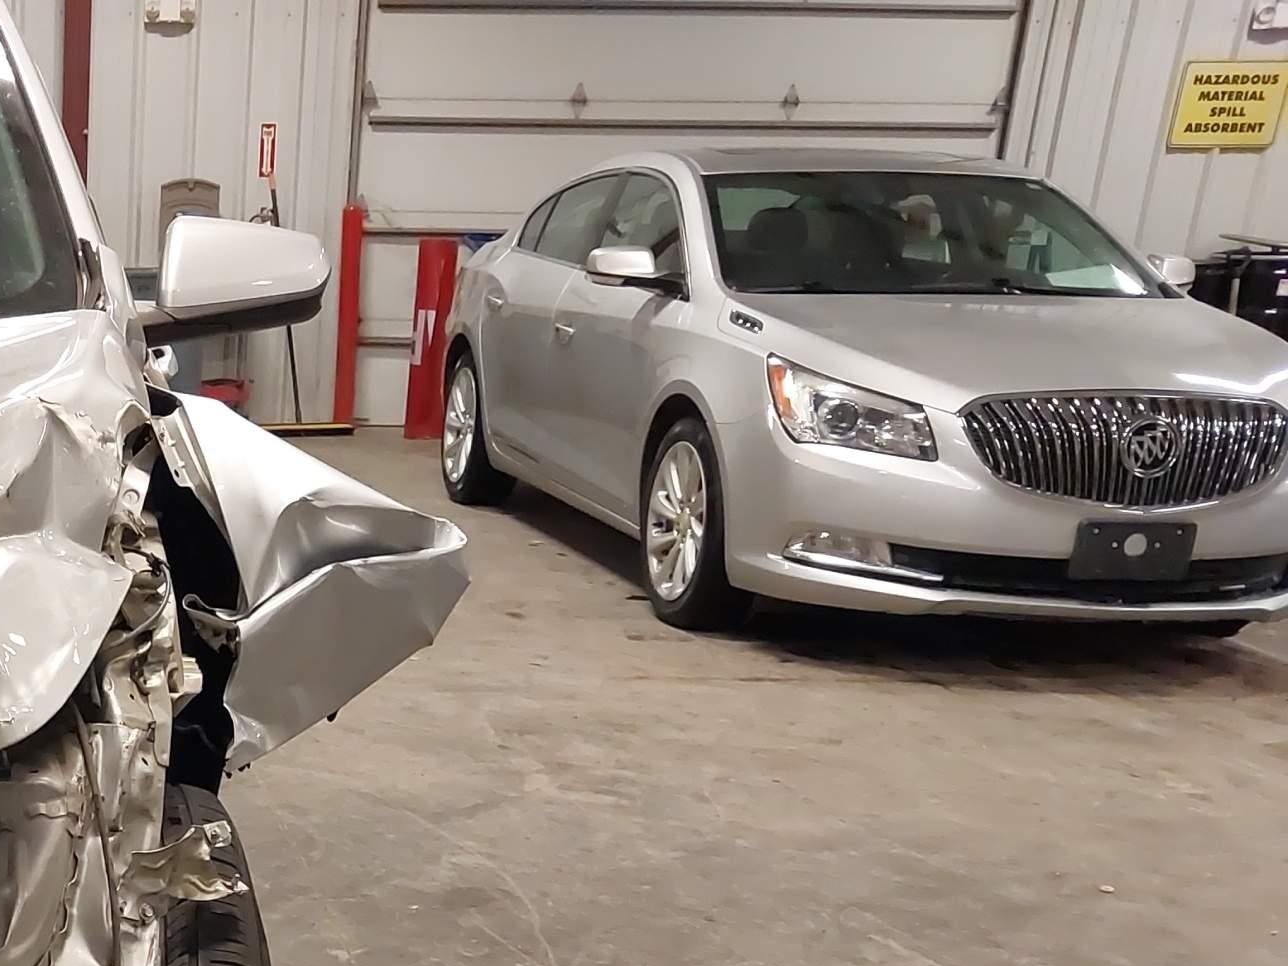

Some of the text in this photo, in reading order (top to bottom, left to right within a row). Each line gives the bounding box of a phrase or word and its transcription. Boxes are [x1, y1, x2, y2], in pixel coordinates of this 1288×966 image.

[1193, 74, 1280, 86] HAZARDOUS
[1198, 90, 1265, 102] MATERIAL
[1209, 106, 1246, 118] SPILL
[1183, 122, 1265, 133] ABSORBENT
